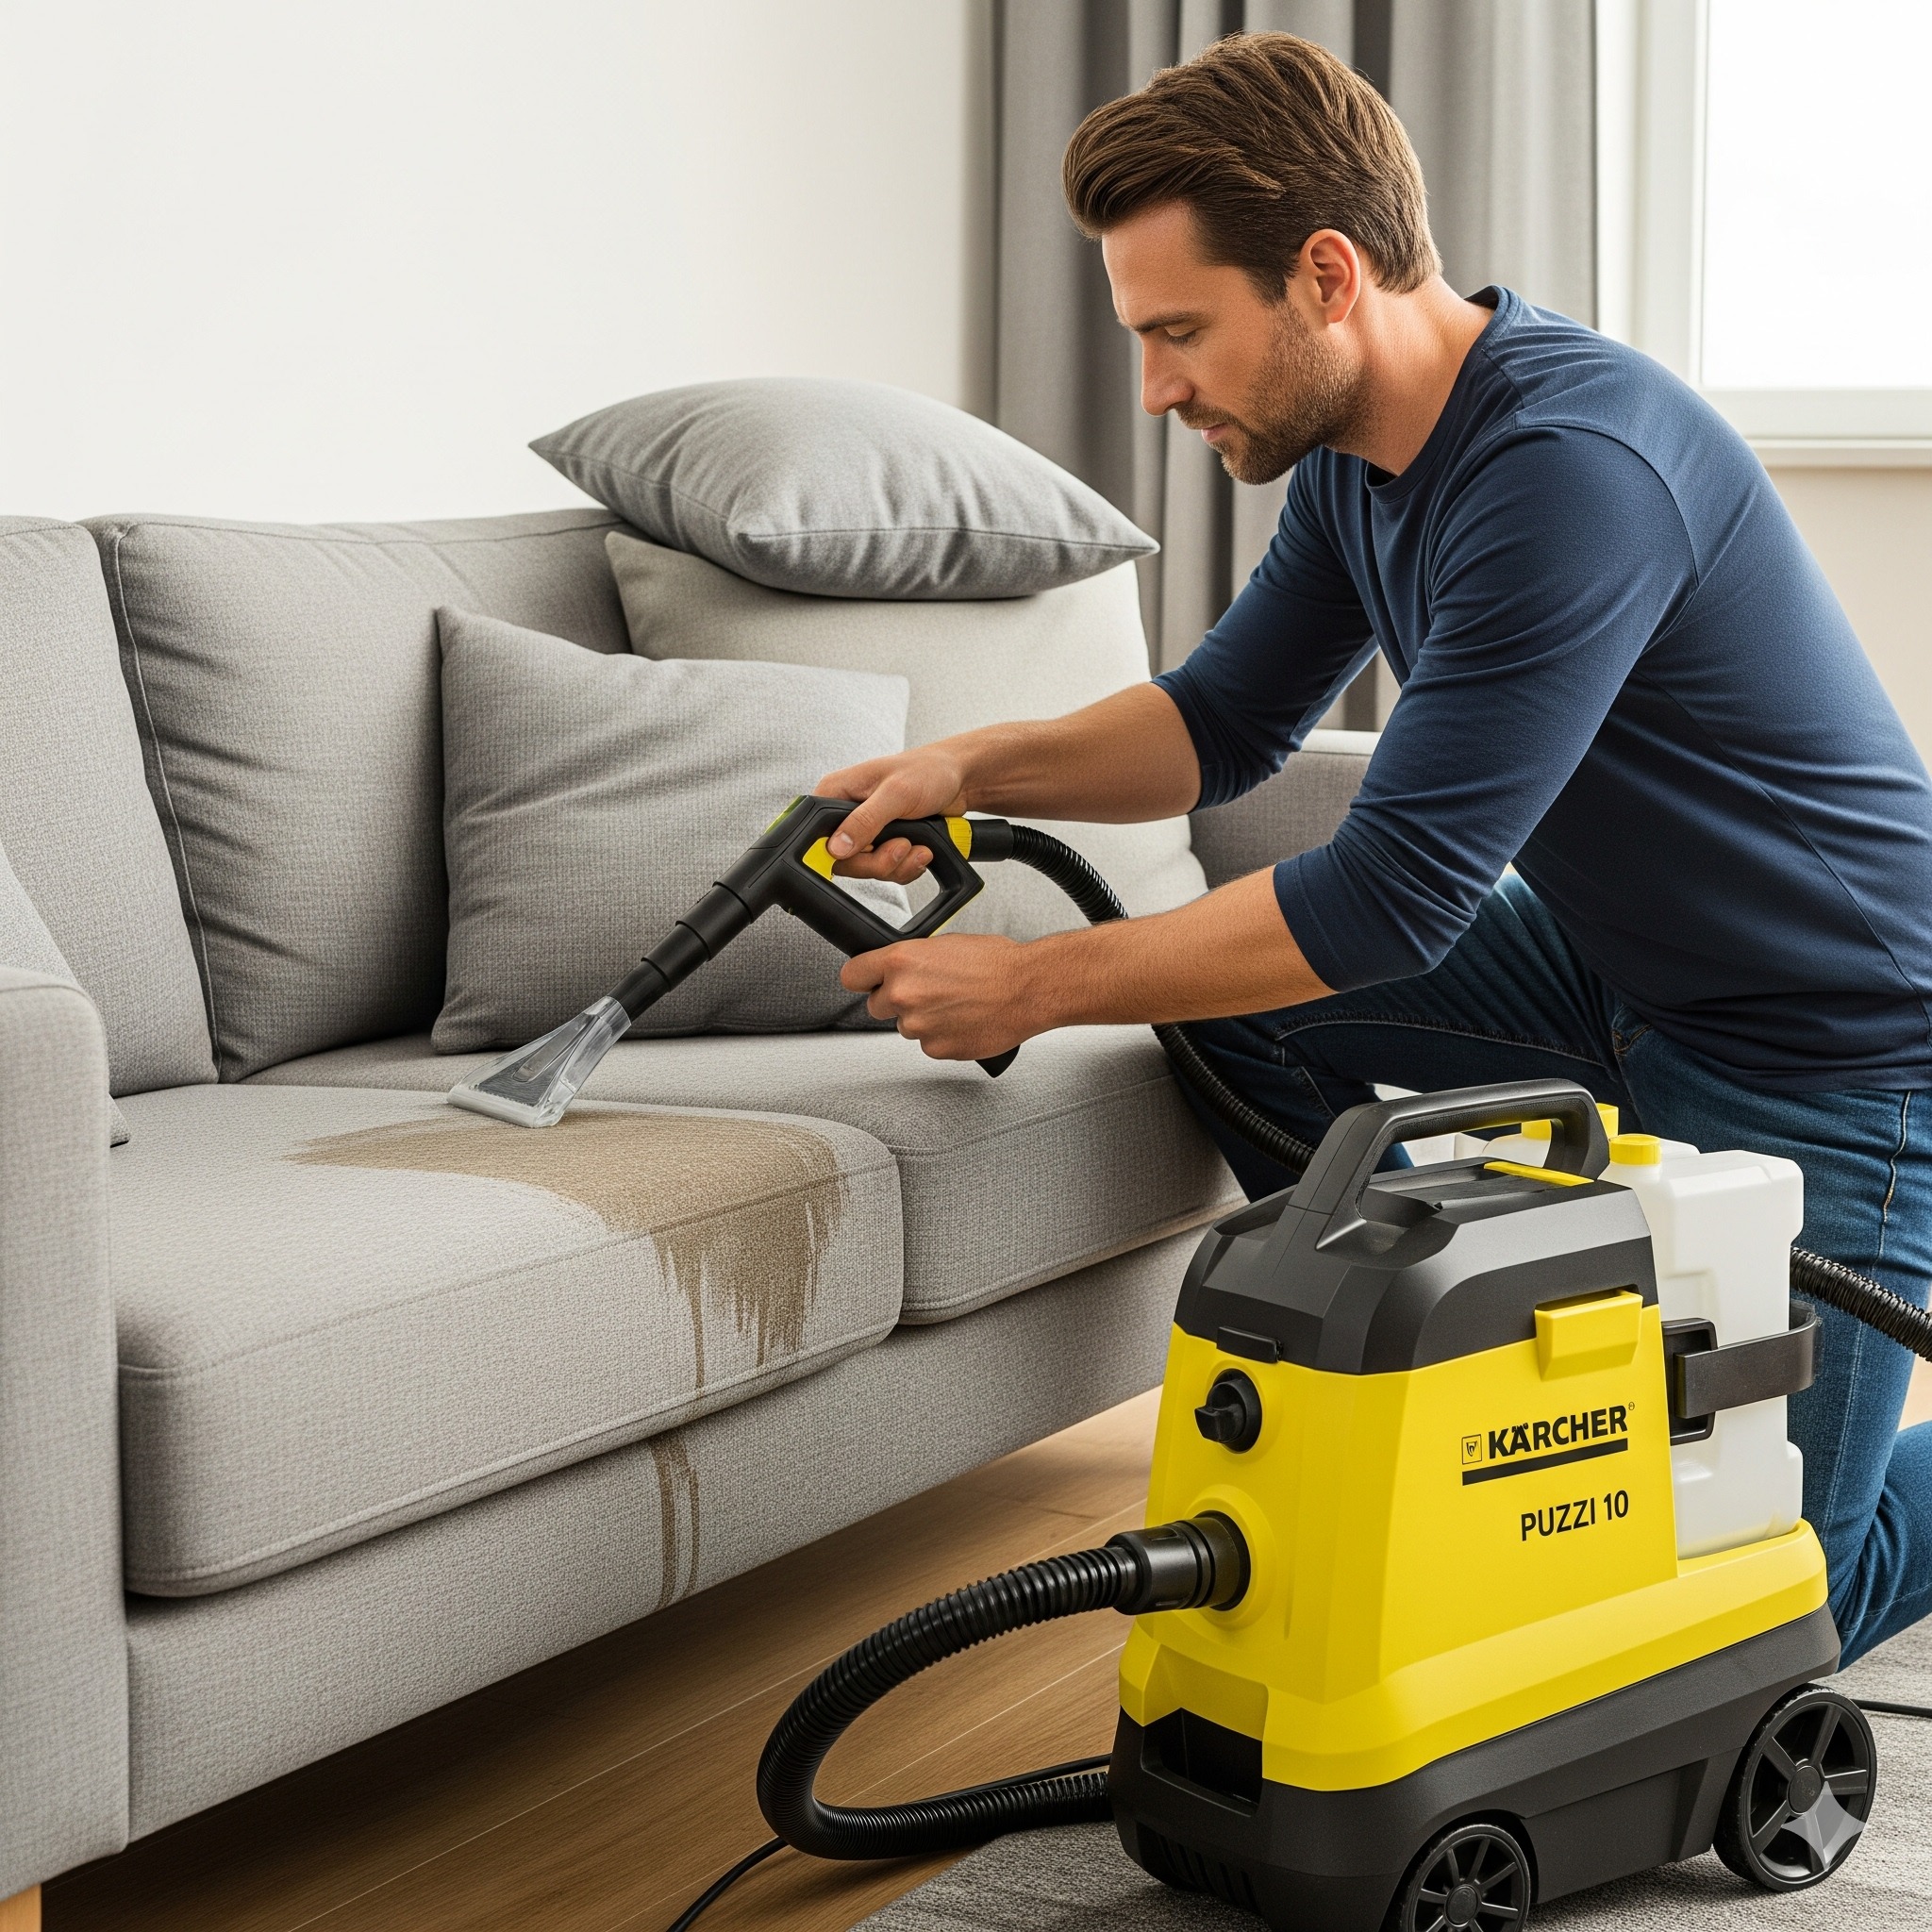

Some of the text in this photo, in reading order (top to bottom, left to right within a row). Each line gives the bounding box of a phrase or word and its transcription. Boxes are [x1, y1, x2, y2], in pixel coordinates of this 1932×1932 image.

[1488, 1405, 1628, 1459] KÄRCHER
[1521, 1490, 1629, 1541] PUZZI 10
